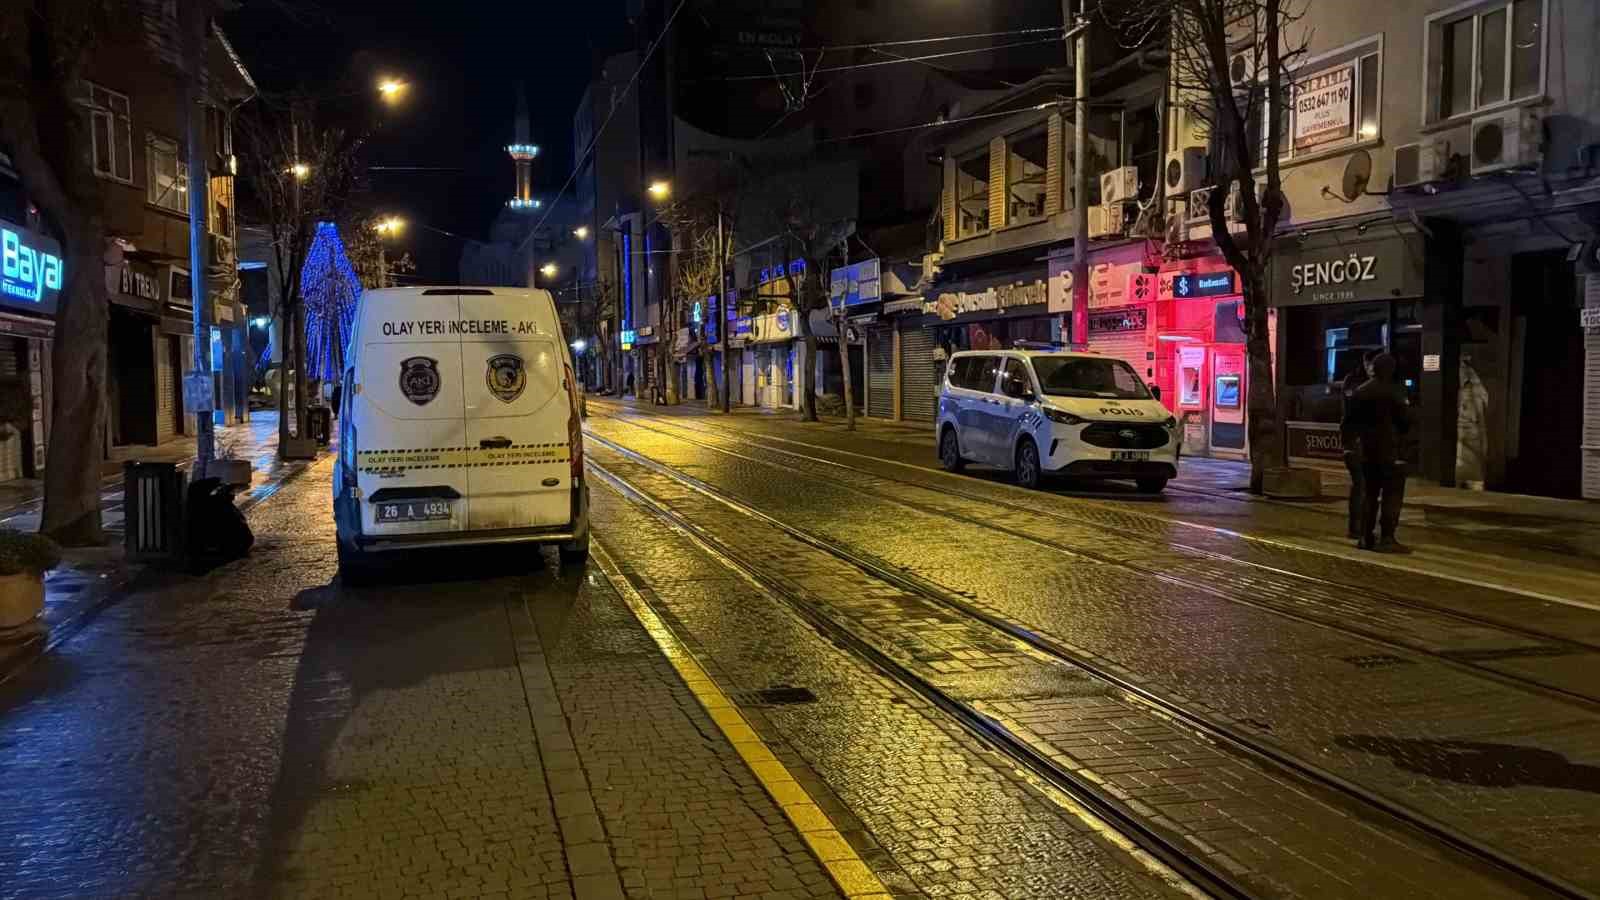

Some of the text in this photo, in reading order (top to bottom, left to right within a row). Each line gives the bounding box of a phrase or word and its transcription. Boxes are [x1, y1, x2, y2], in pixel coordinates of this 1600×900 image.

[1299, 96, 1316, 113] 0532
[1317, 91, 1330, 108] 647
[1339, 86, 1349, 103] 90
[1291, 253, 1376, 294] ŞENGÖZ
[382, 321, 413, 336] OLAY
[384, 502, 450, 519] 26 A 4934
